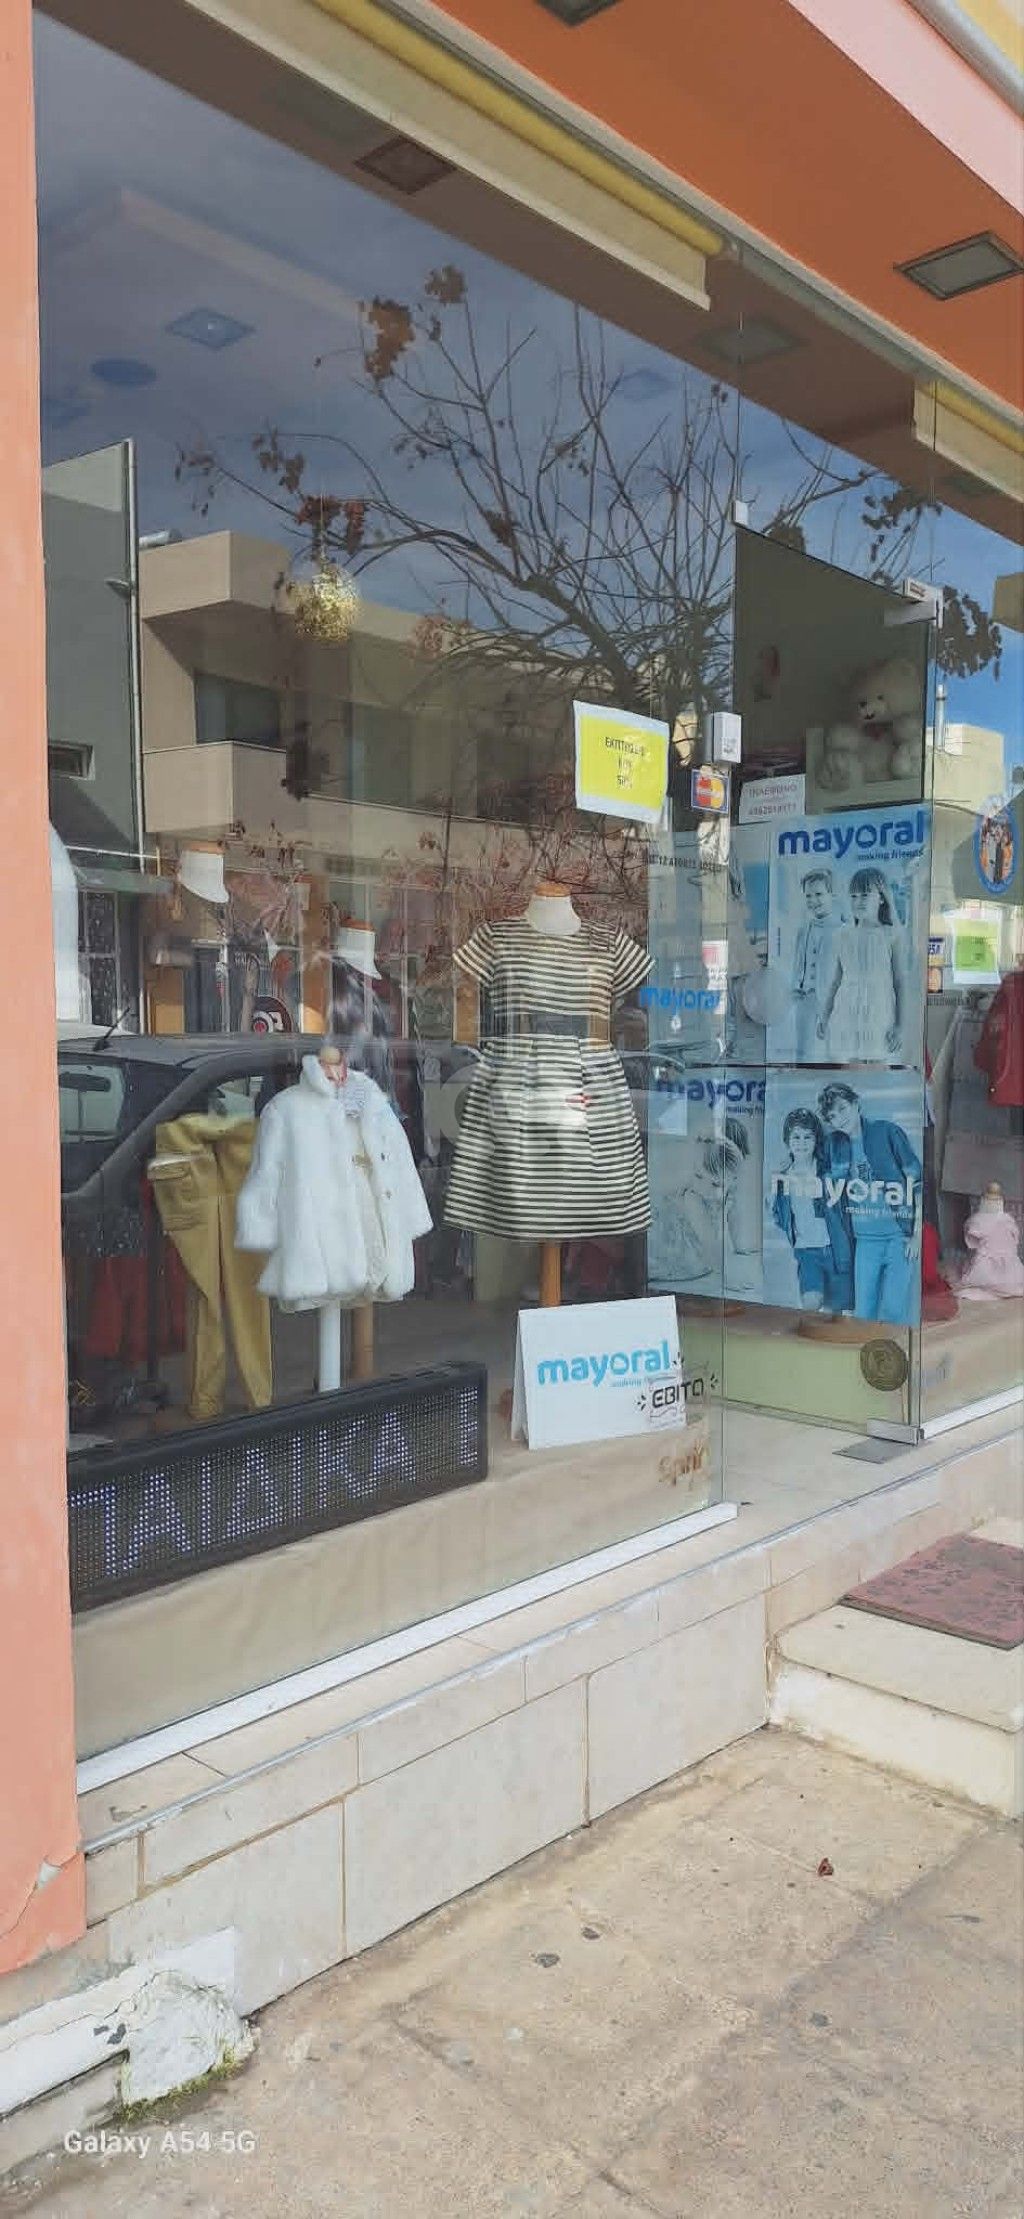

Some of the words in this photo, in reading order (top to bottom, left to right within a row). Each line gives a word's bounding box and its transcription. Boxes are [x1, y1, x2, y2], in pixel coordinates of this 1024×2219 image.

[778, 810, 925, 858] mayoral
[656, 1078, 766, 1109] mayora
[771, 1174, 914, 1208] mayoral
[537, 1339, 671, 1387] mayoral
